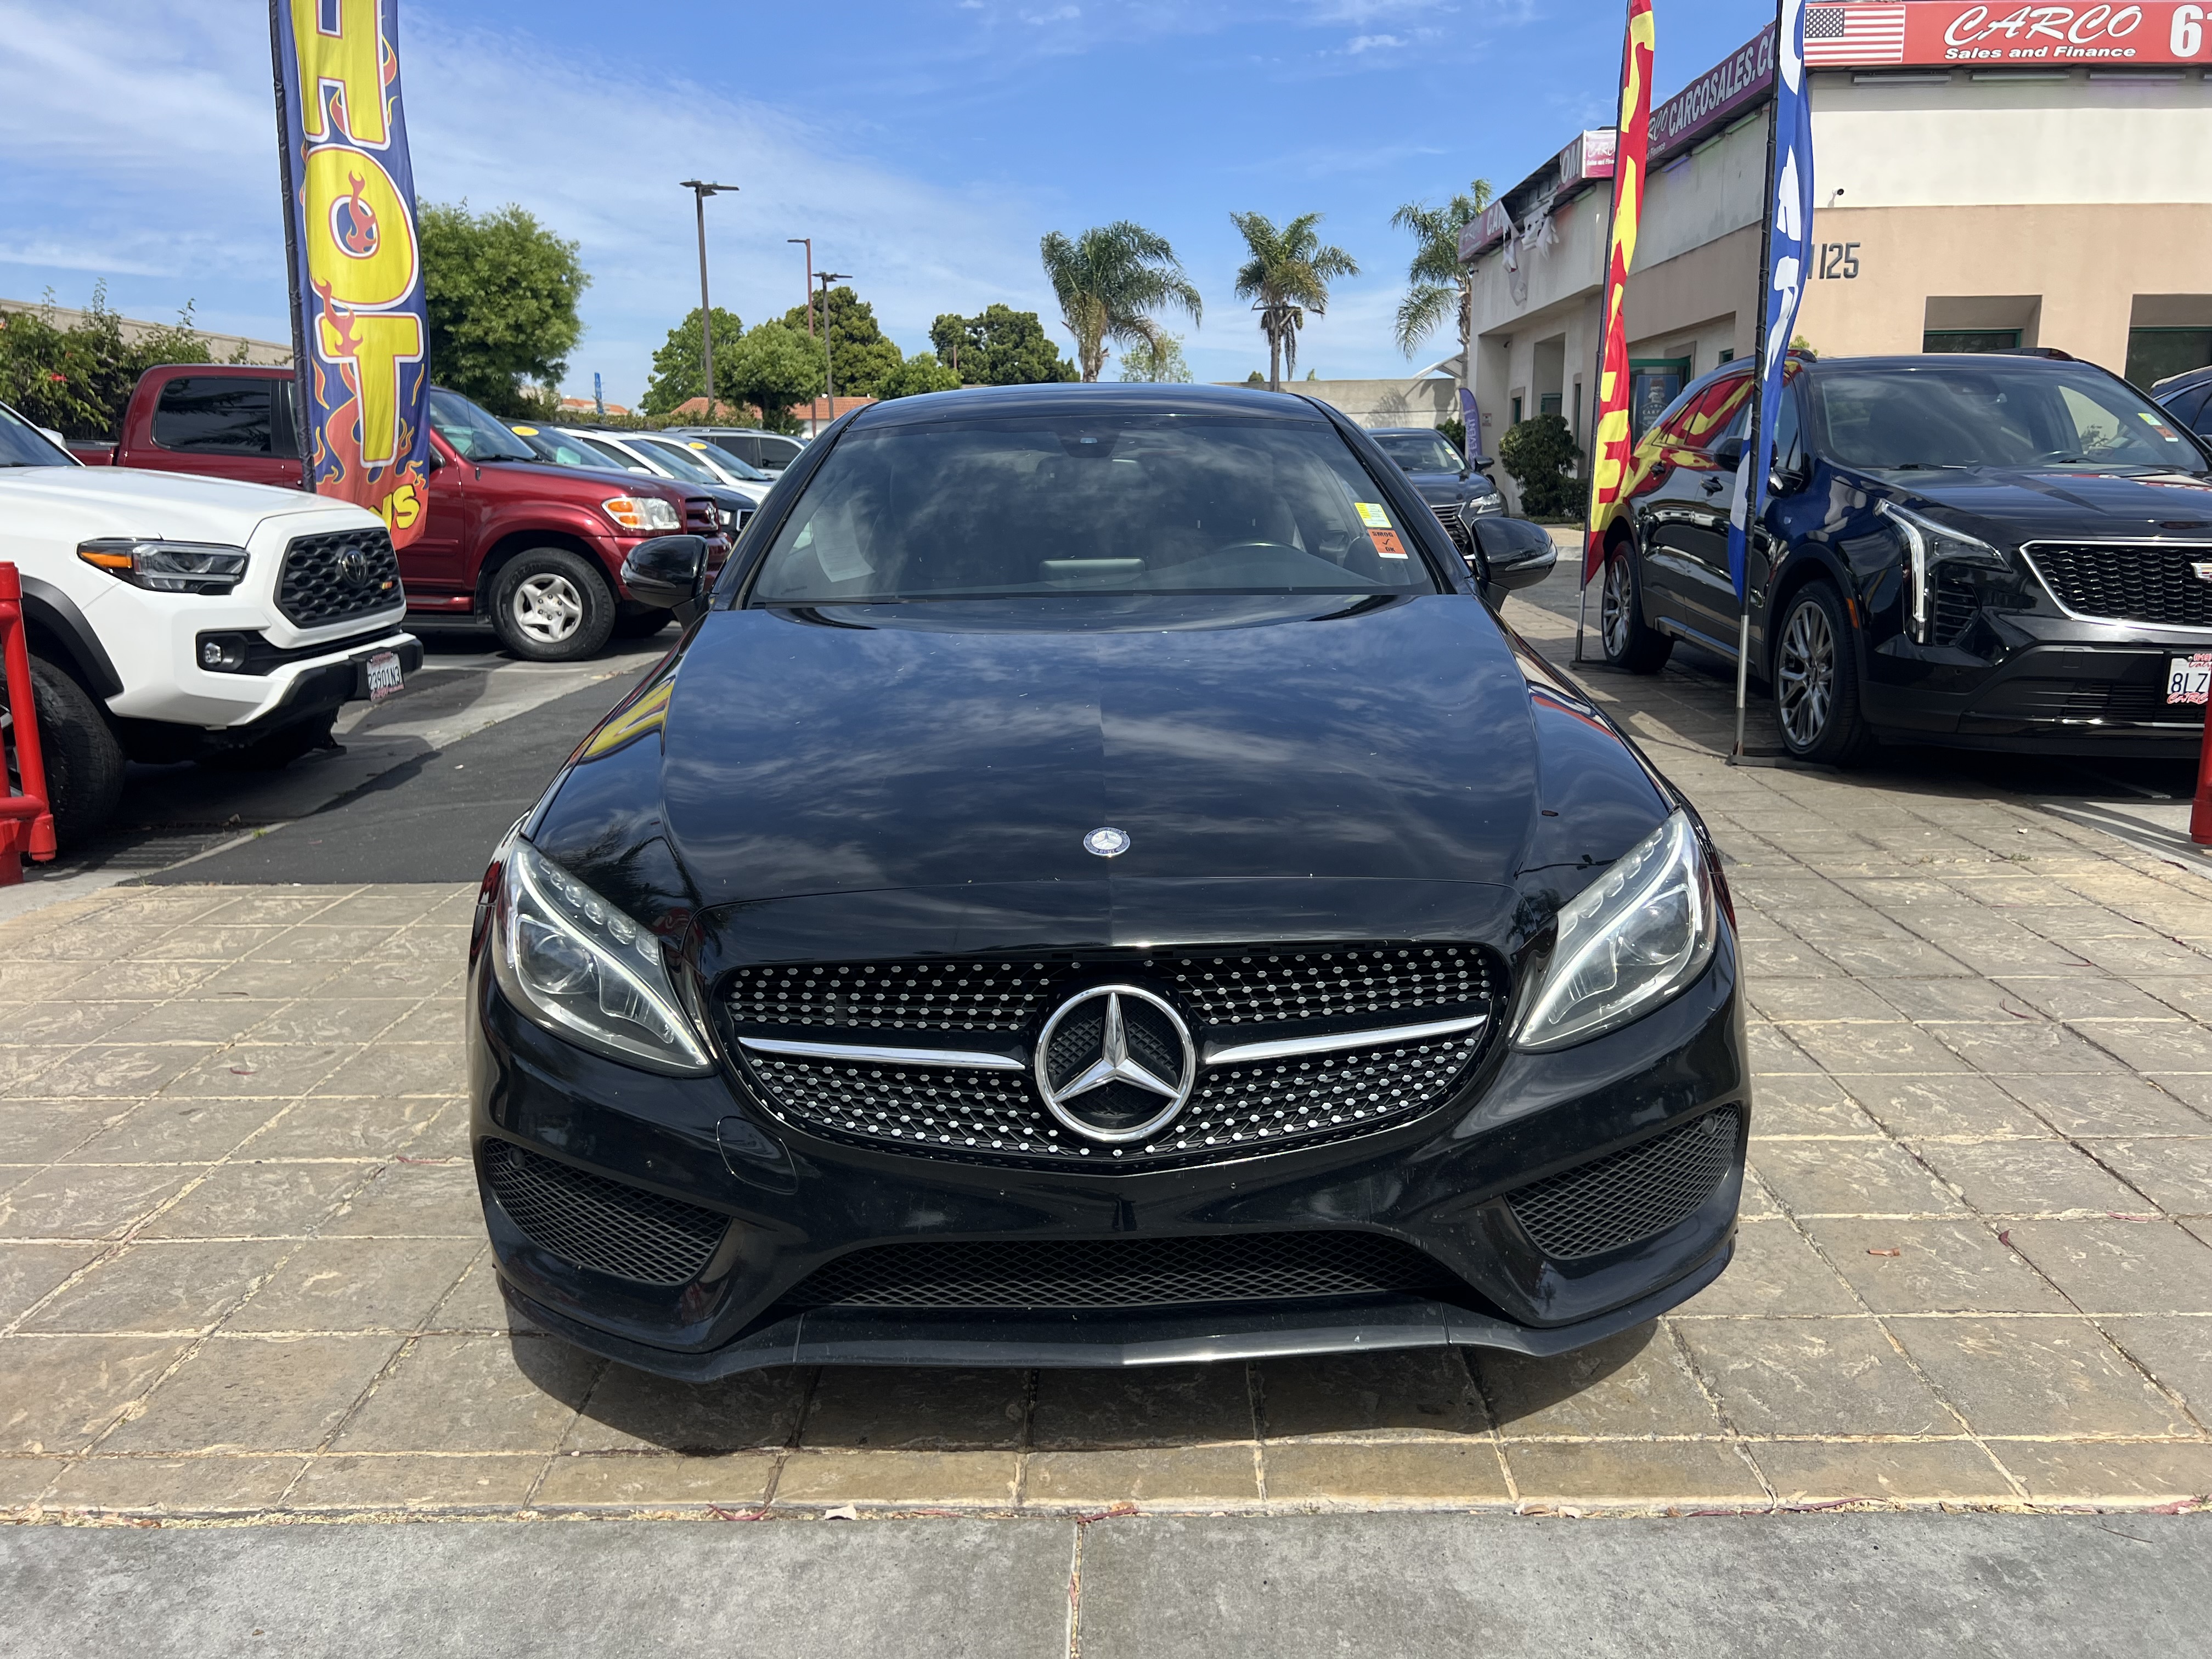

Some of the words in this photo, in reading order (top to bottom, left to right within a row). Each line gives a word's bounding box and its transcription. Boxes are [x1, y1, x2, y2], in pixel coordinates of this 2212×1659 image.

[1943, 4, 2142, 47] CARCO
[1944, 47, 2002, 60] Sales
[2008, 46, 2048, 59] and
[2053, 46, 2136, 58] Finance
[290, 0, 424, 469] HOT
[368, 666, 400, 692] 23901N3
